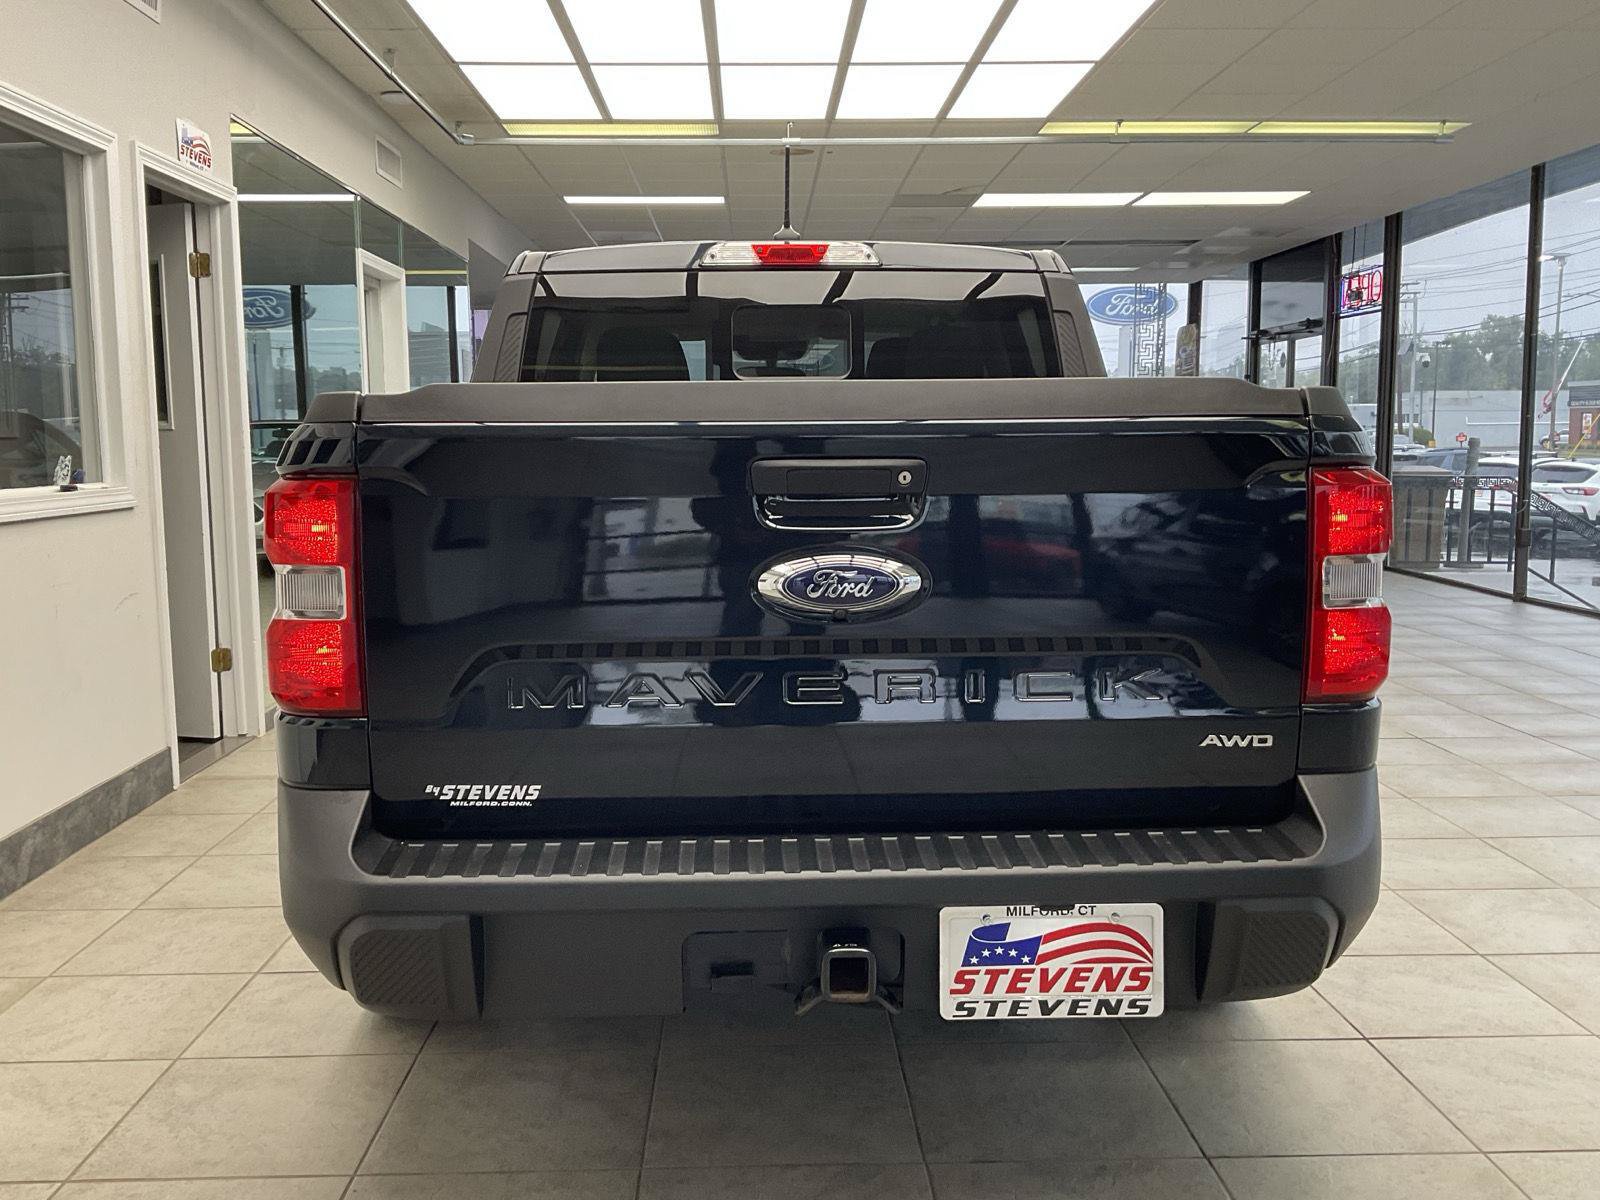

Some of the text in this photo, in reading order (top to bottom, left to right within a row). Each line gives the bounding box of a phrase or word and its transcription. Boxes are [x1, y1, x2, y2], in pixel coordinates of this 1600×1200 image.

[180, 144, 212, 169] STEVENS
[1105, 293, 1159, 315] Ford
[806, 569, 876, 599] Ford
[507, 667, 1164, 709] MAVERICK
[1199, 734, 1274, 748] AWD
[439, 784, 542, 800] STEVENS
[1078, 905, 1097, 916] CT
[950, 966, 1153, 995] STEVENS
[952, 998, 1152, 1018] STEVENS
